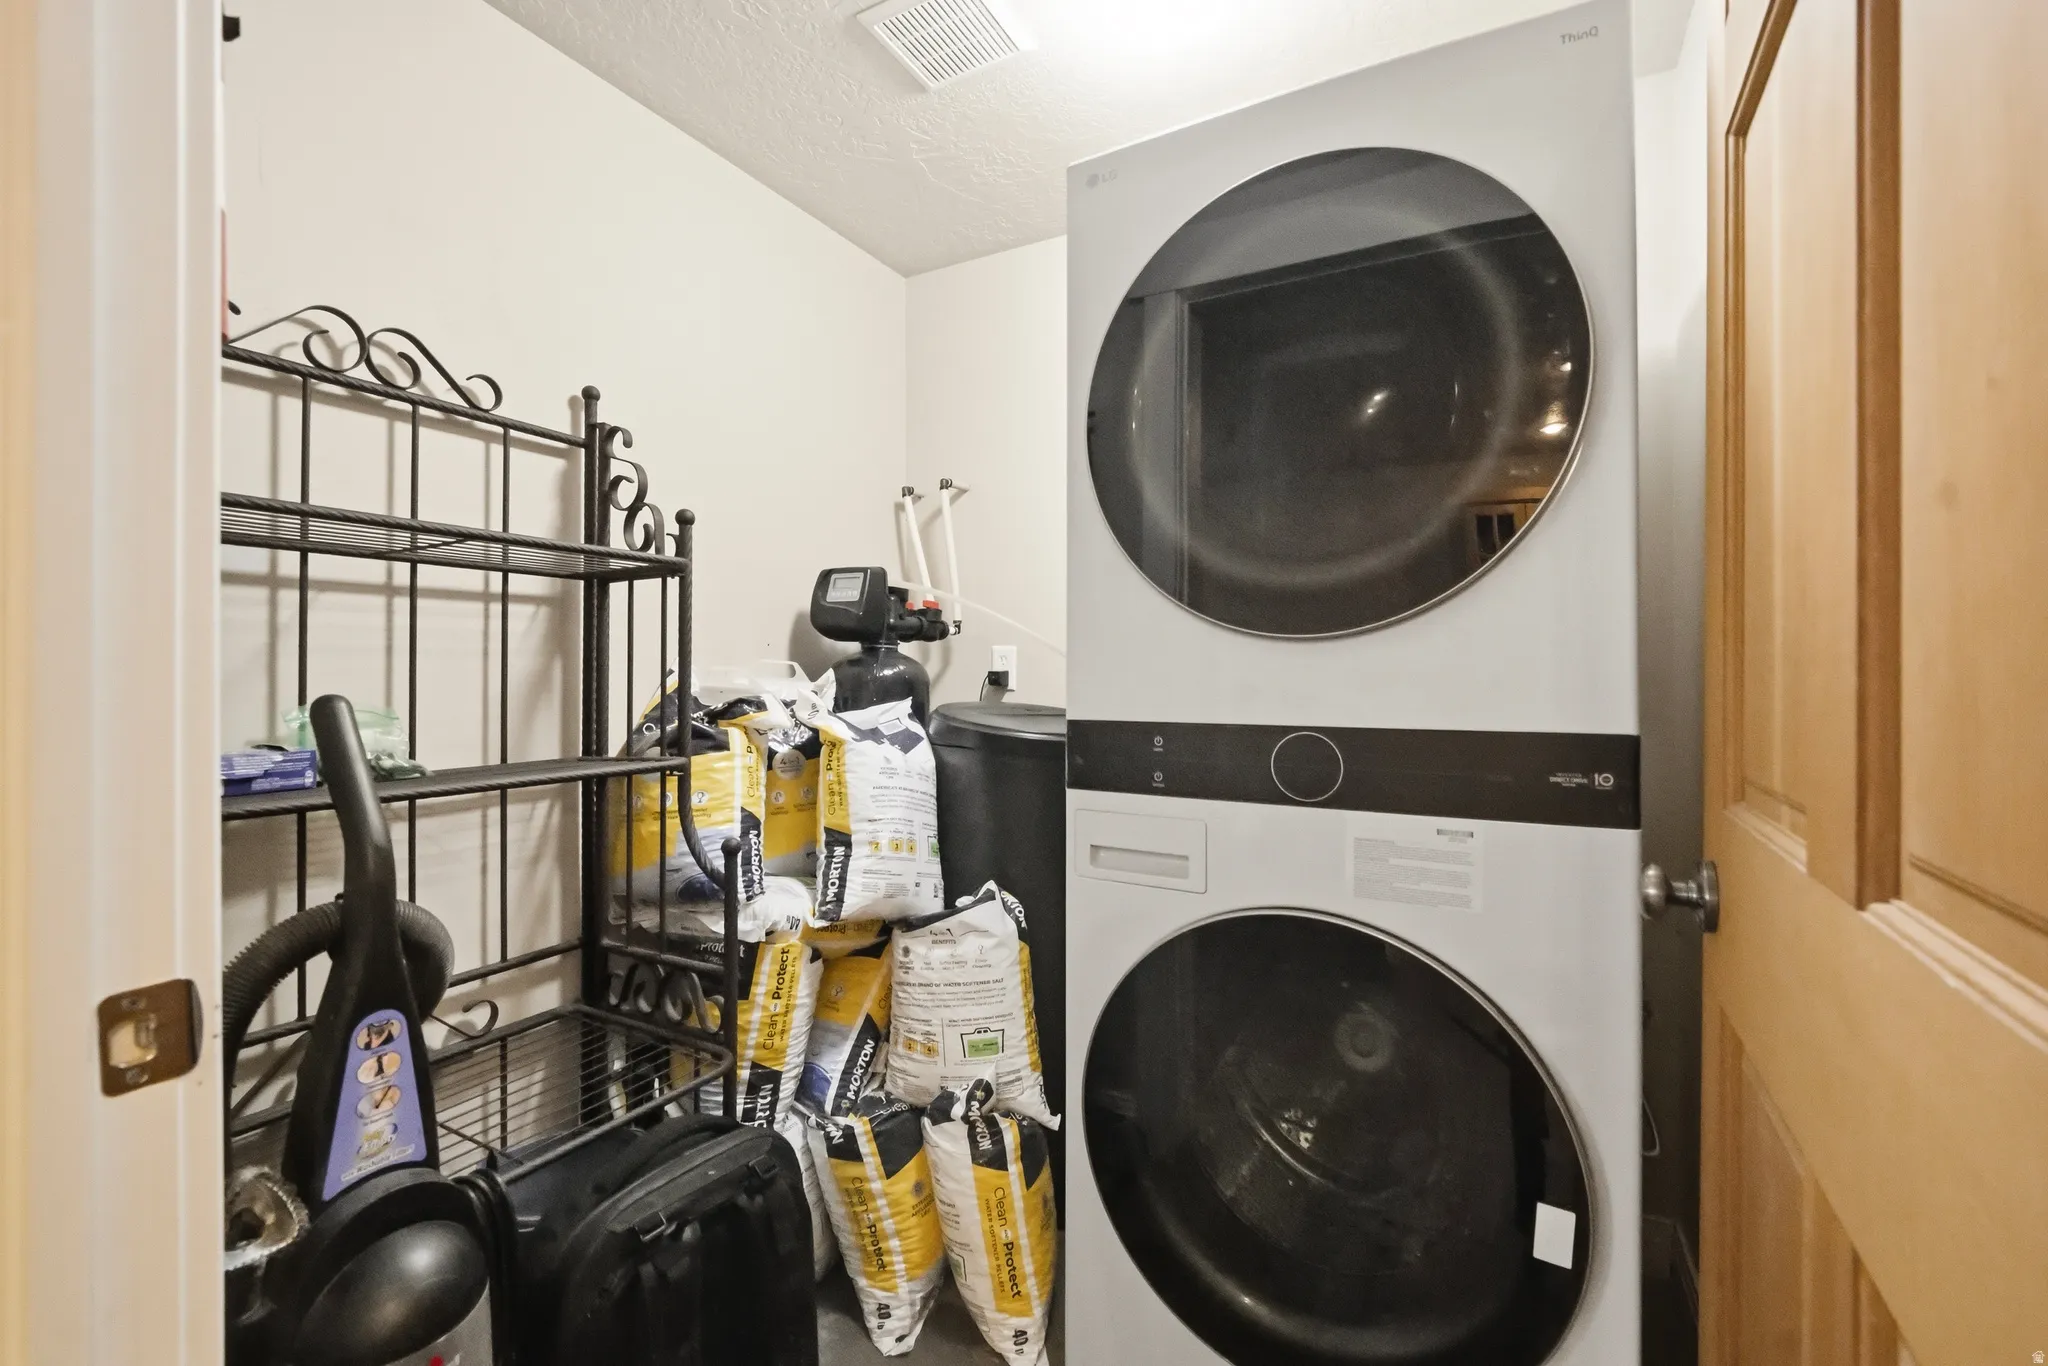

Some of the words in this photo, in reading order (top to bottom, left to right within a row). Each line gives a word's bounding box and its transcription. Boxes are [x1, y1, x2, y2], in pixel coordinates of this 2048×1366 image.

[1560, 26, 1599, 45] ThinQ
[1101, 168, 1118, 183] LG
[826, 782, 837, 816] Clean
[1594, 773, 1614, 787] 10
[749, 830, 764, 888] MORTON
[825, 846, 846, 902] MORTON
[1000, 890, 1028, 930] ORTON
[771, 947, 791, 1001] Protect
[762, 1012, 781, 1051] Clean
[846, 1037, 876, 1100] MORTON
[753, 1083, 774, 1129] ORTON
[967, 1100, 993, 1151] MORTON
[850, 1176, 870, 1217] Clean
[865, 1223, 888, 1272] Protect
[983, 1198, 994, 1222] WATER
[988, 1223, 1001, 1262] SOFTENER
[992, 1186, 1008, 1229] Clean
[1002, 1240, 1023, 1299] Protect
[876, 1302, 892, 1320] 40
[1011, 1328, 1030, 1347] 40
